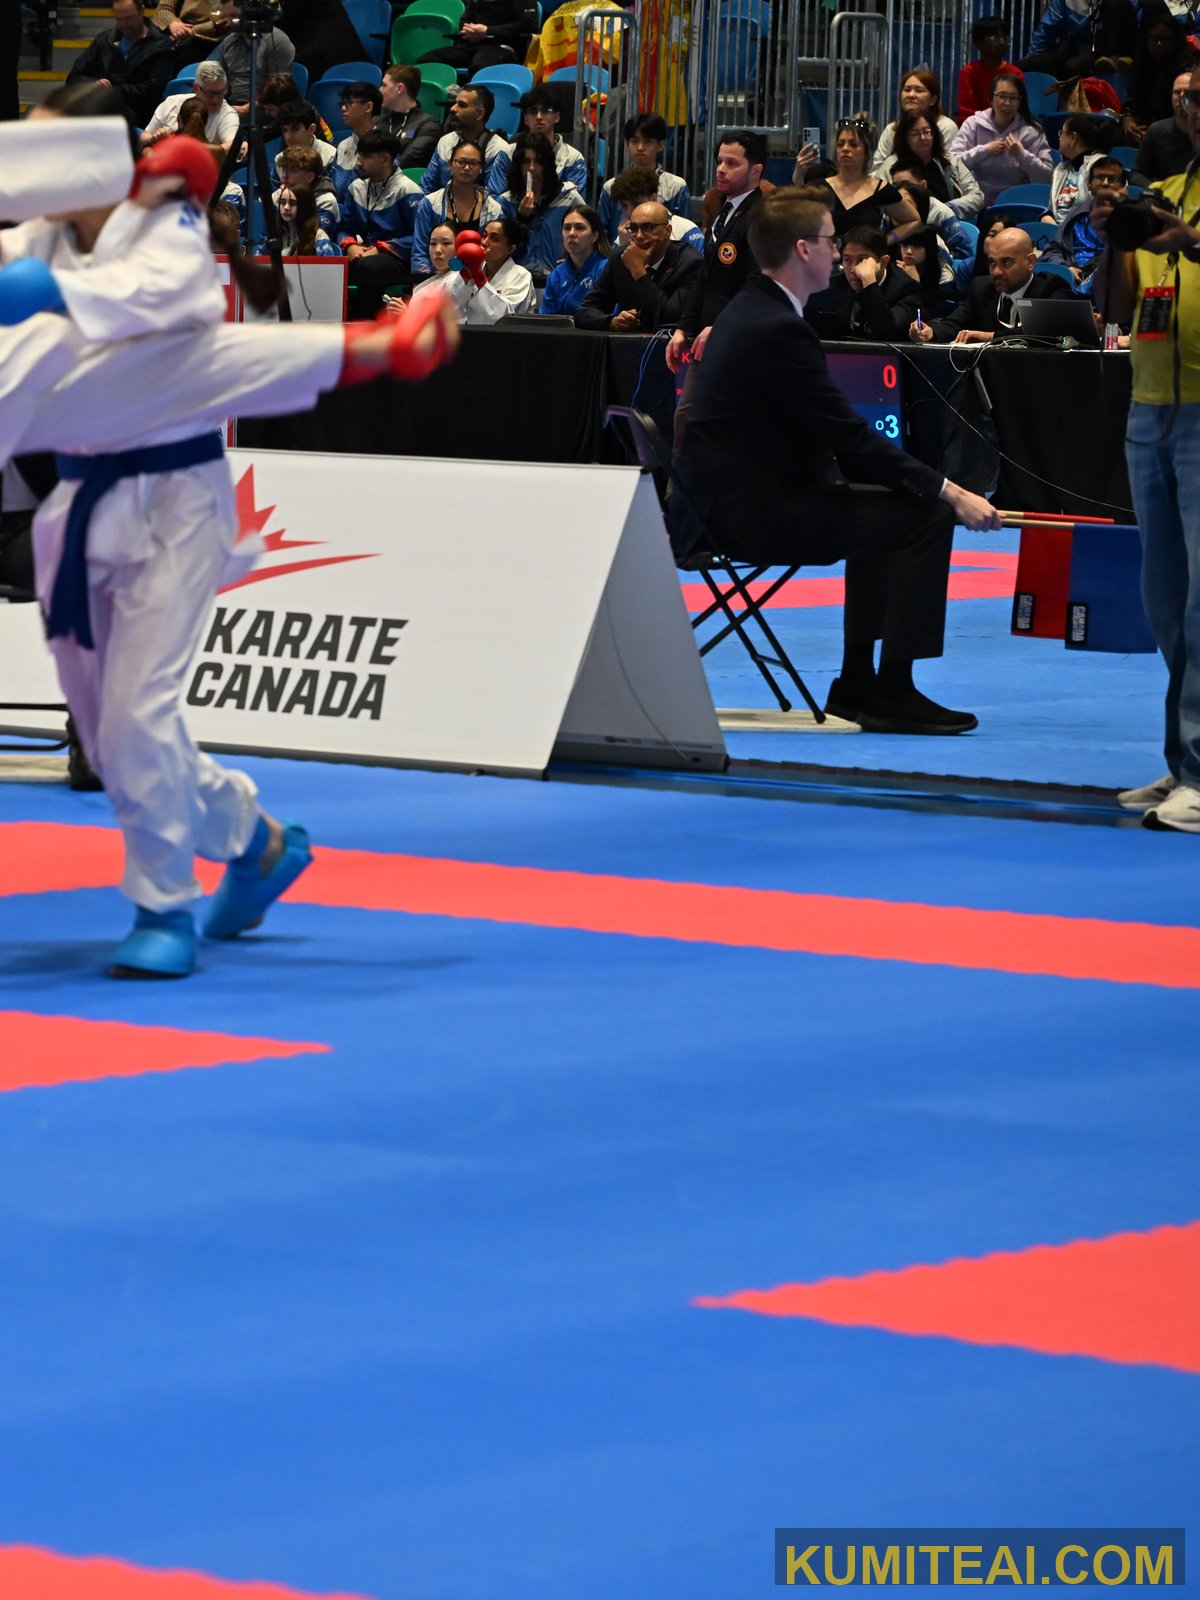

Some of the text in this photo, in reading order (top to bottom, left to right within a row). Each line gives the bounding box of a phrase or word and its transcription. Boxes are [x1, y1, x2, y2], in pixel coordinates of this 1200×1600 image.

[883, 364, 897, 389] 0
[203, 607, 410, 665] KARATE
[186, 661, 387, 721] CANADA
